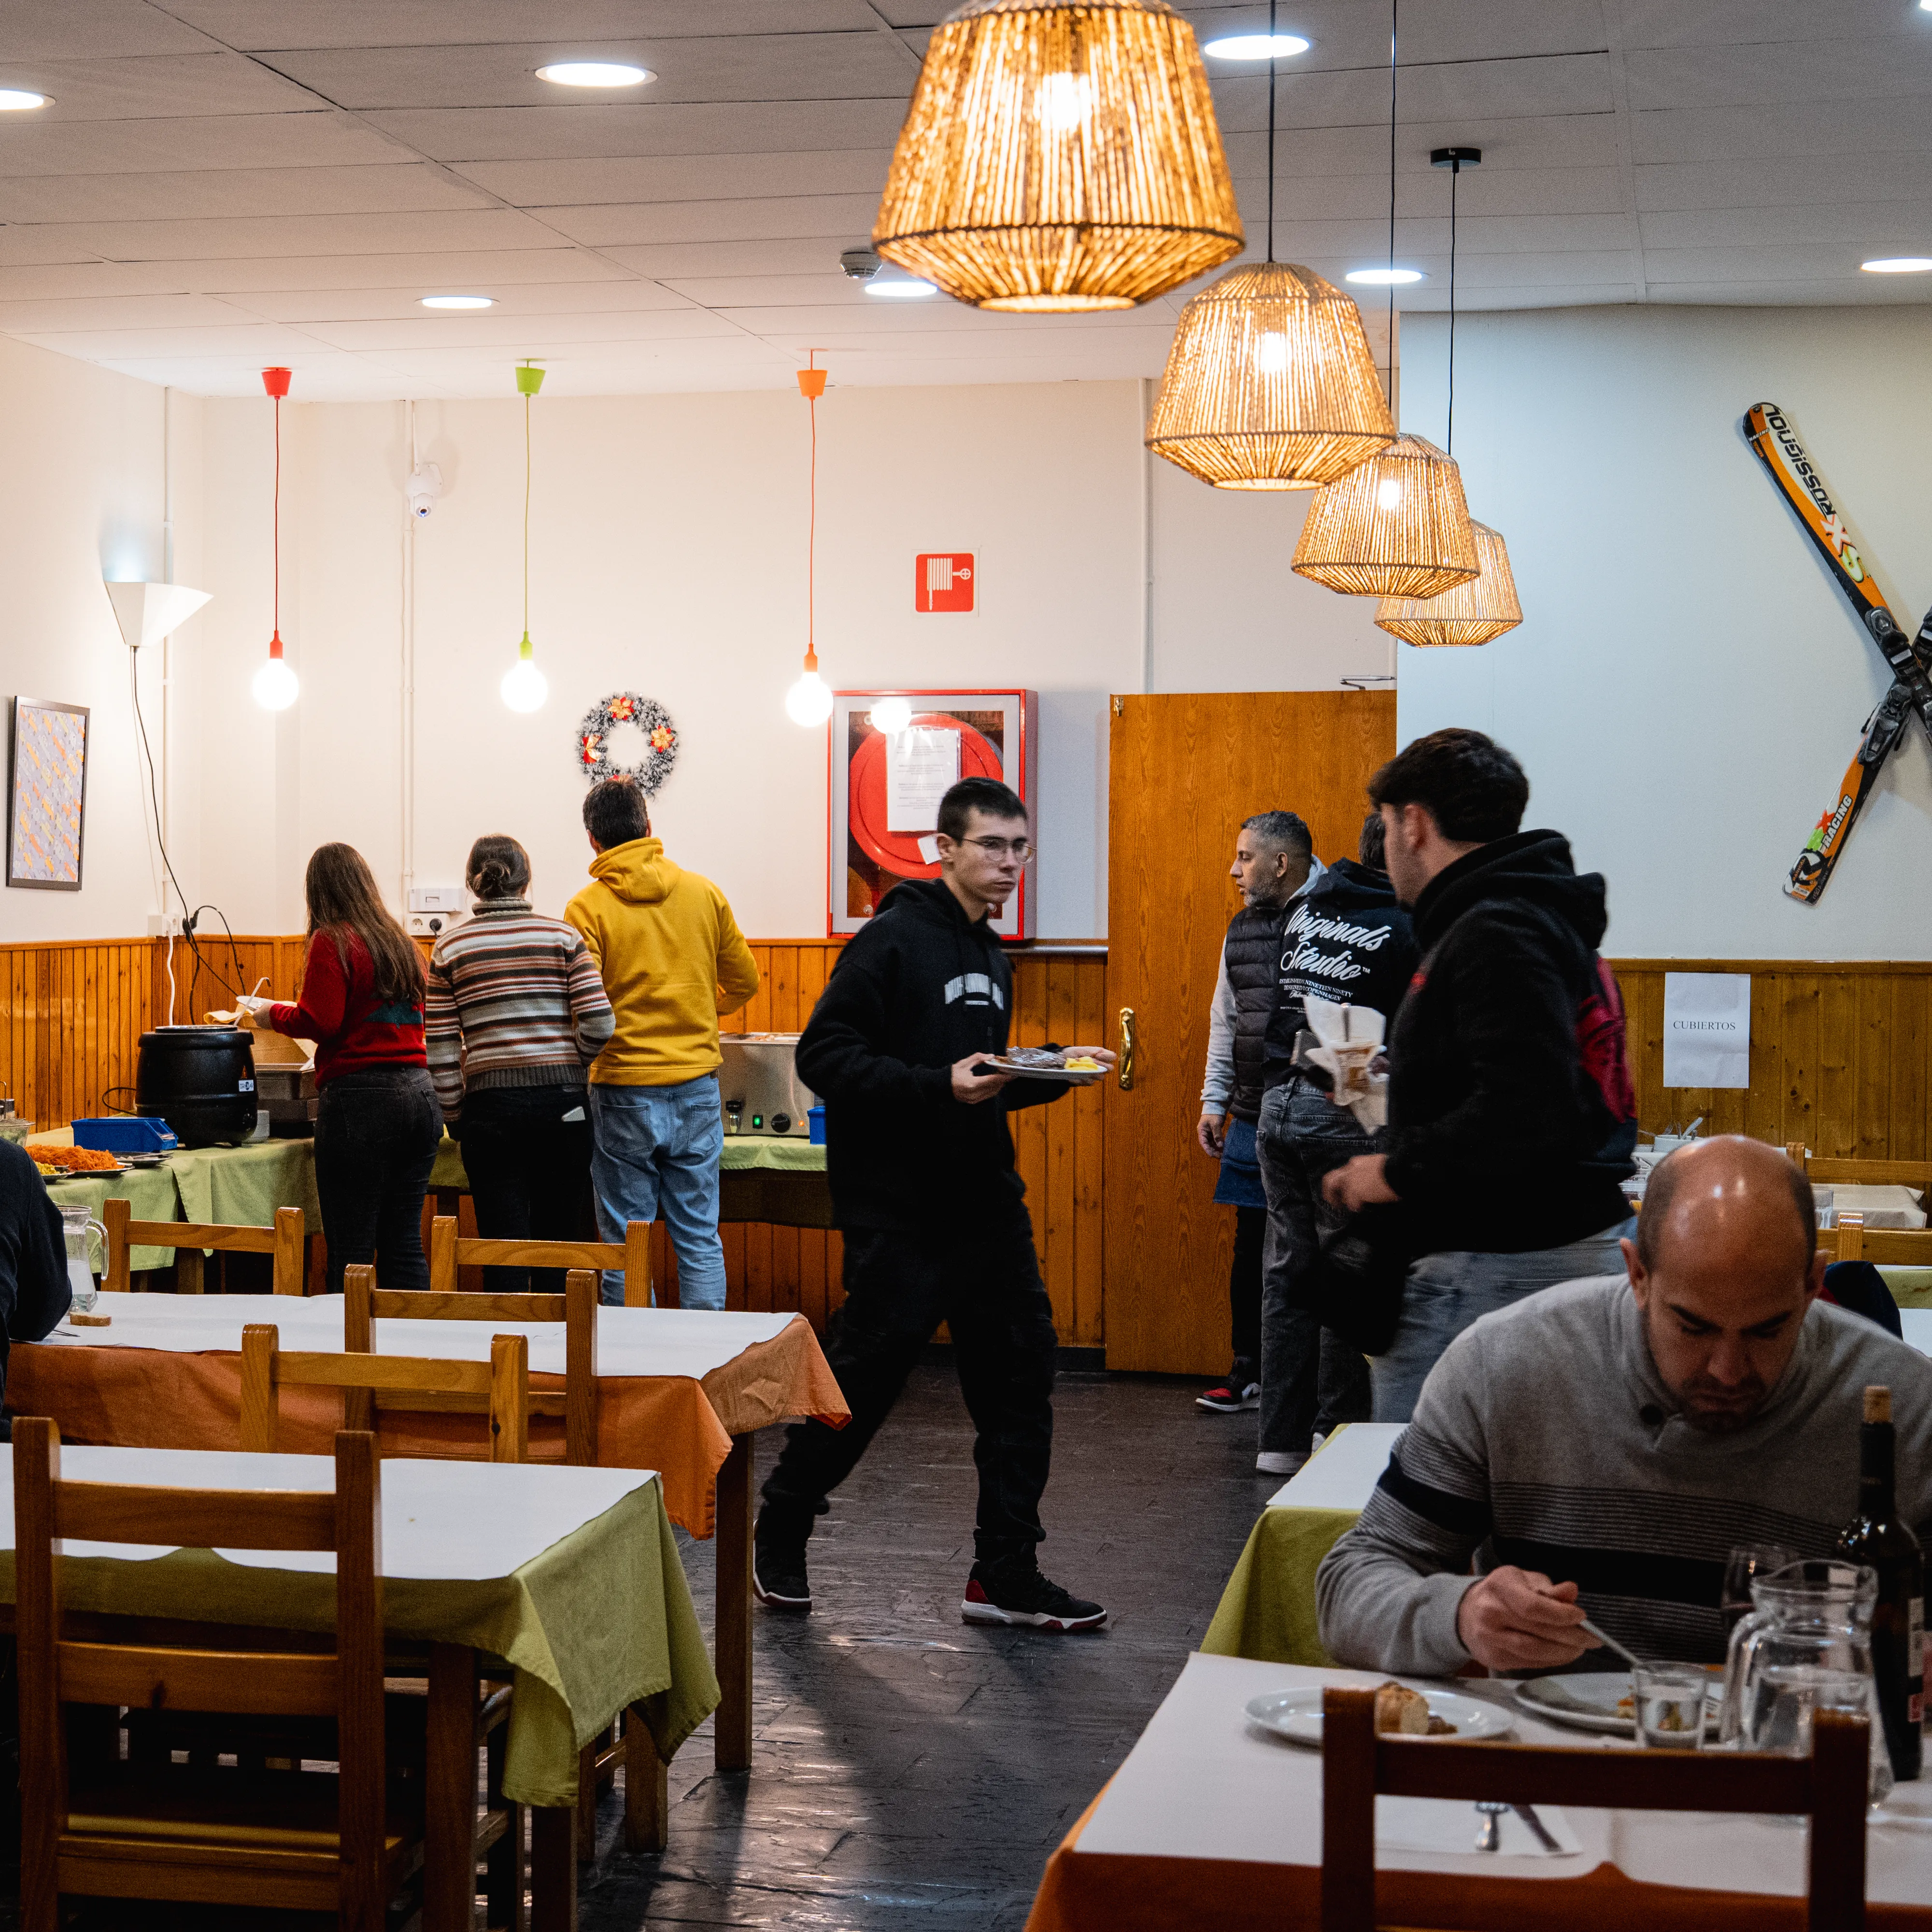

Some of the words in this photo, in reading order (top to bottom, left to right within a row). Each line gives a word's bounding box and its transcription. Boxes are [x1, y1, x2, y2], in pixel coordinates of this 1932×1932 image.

[1765, 406, 1836, 515] ROSSIGNOL
[1821, 794, 1853, 849] RACING
[1285, 904, 1392, 951] Originals
[1305, 980, 1332, 992] NINETEEN
[1333, 987, 1353, 998] NINETY
[1305, 986, 1342, 1002] COPENHAGEN
[1673, 1021, 1736, 1030] CUBIERTOS
